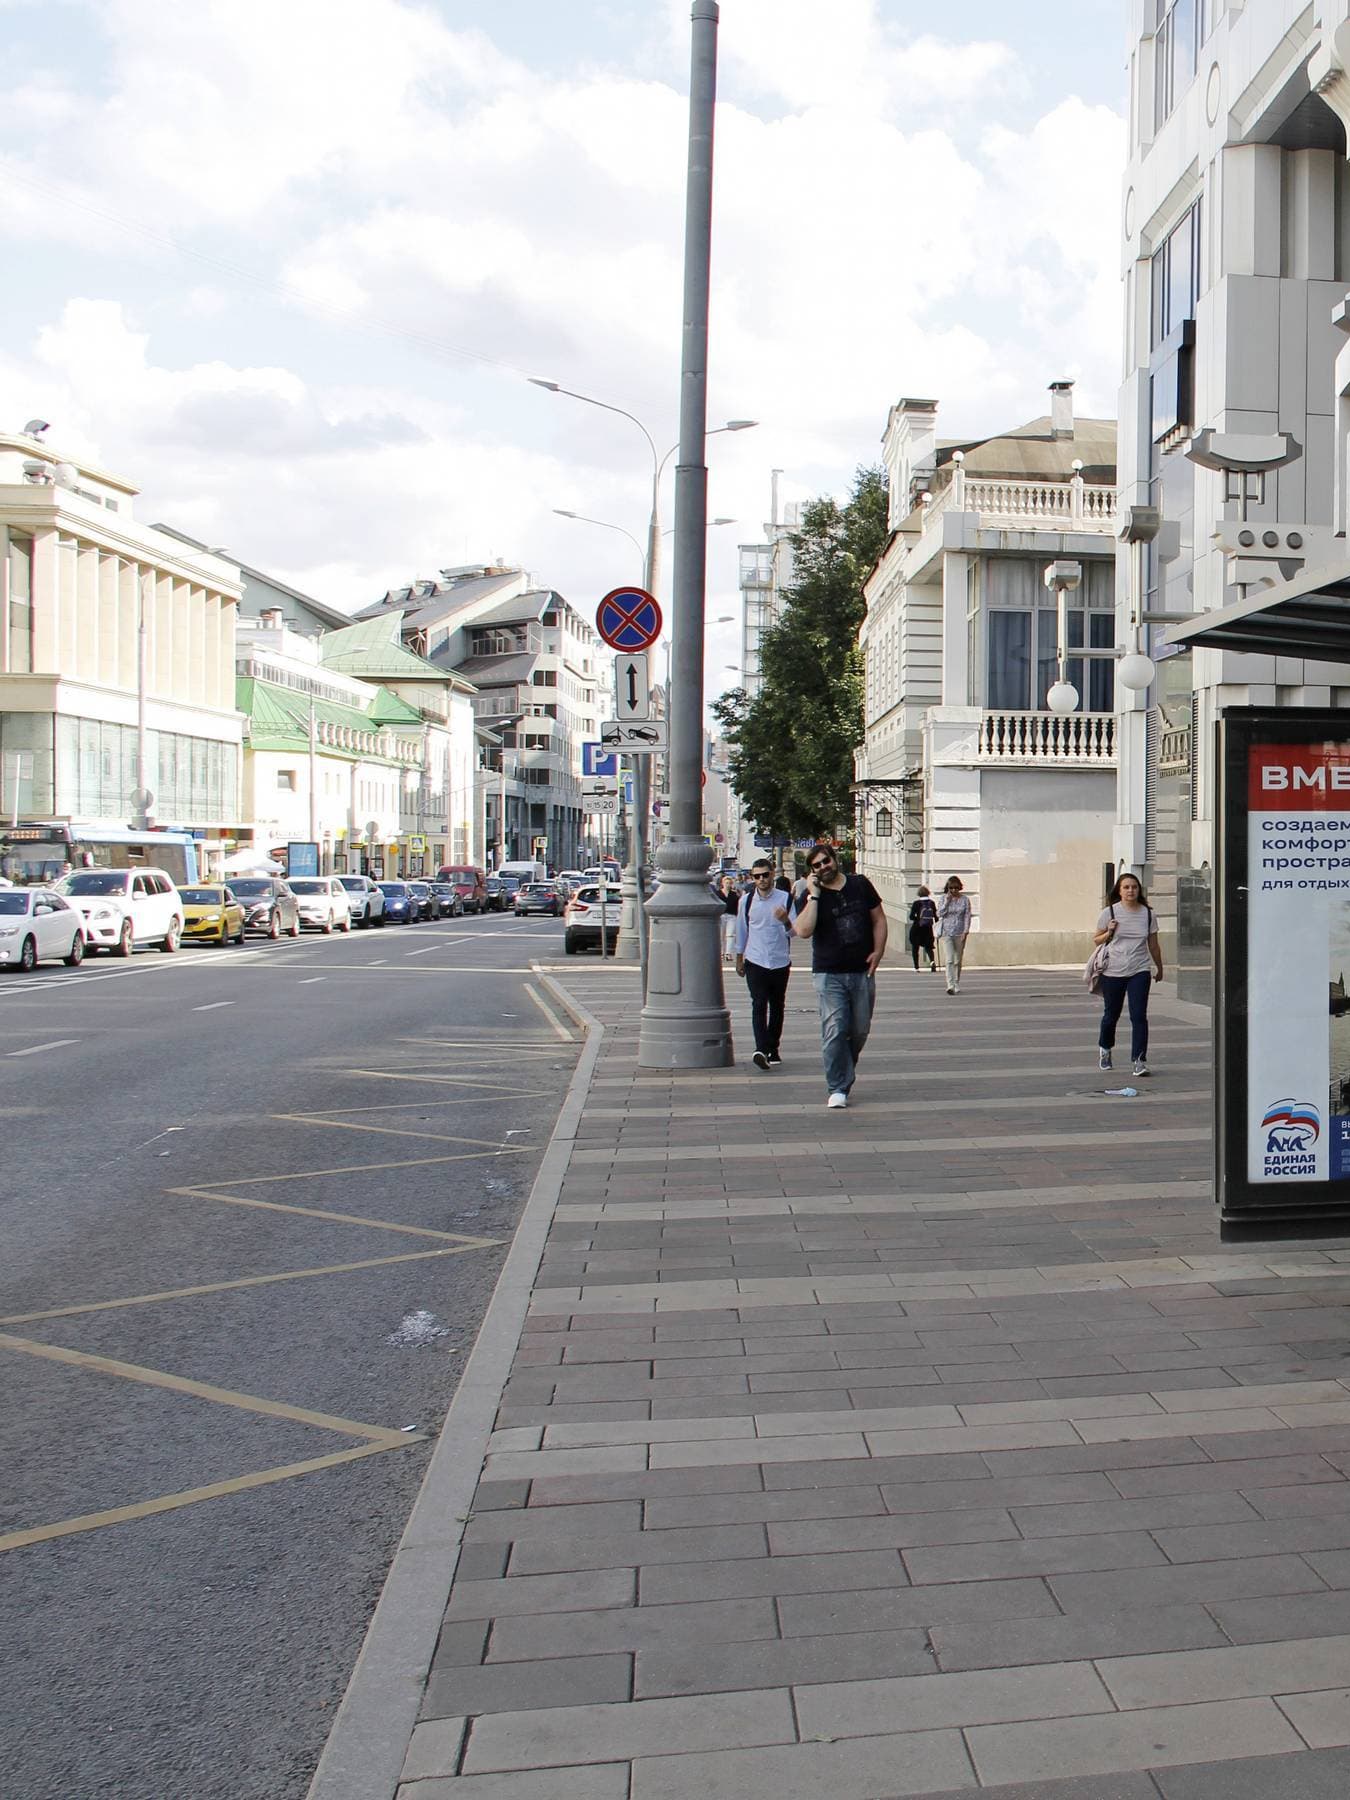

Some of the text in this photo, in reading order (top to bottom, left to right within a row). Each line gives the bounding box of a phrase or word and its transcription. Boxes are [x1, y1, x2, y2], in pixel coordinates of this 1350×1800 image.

[603, 801, 614, 809] 20
[1262, 879, 1293, 891] для
[1264, 1154, 1316, 1166] ЕДИНАЯ
[1264, 1165, 1316, 1176] РОССИЯ
